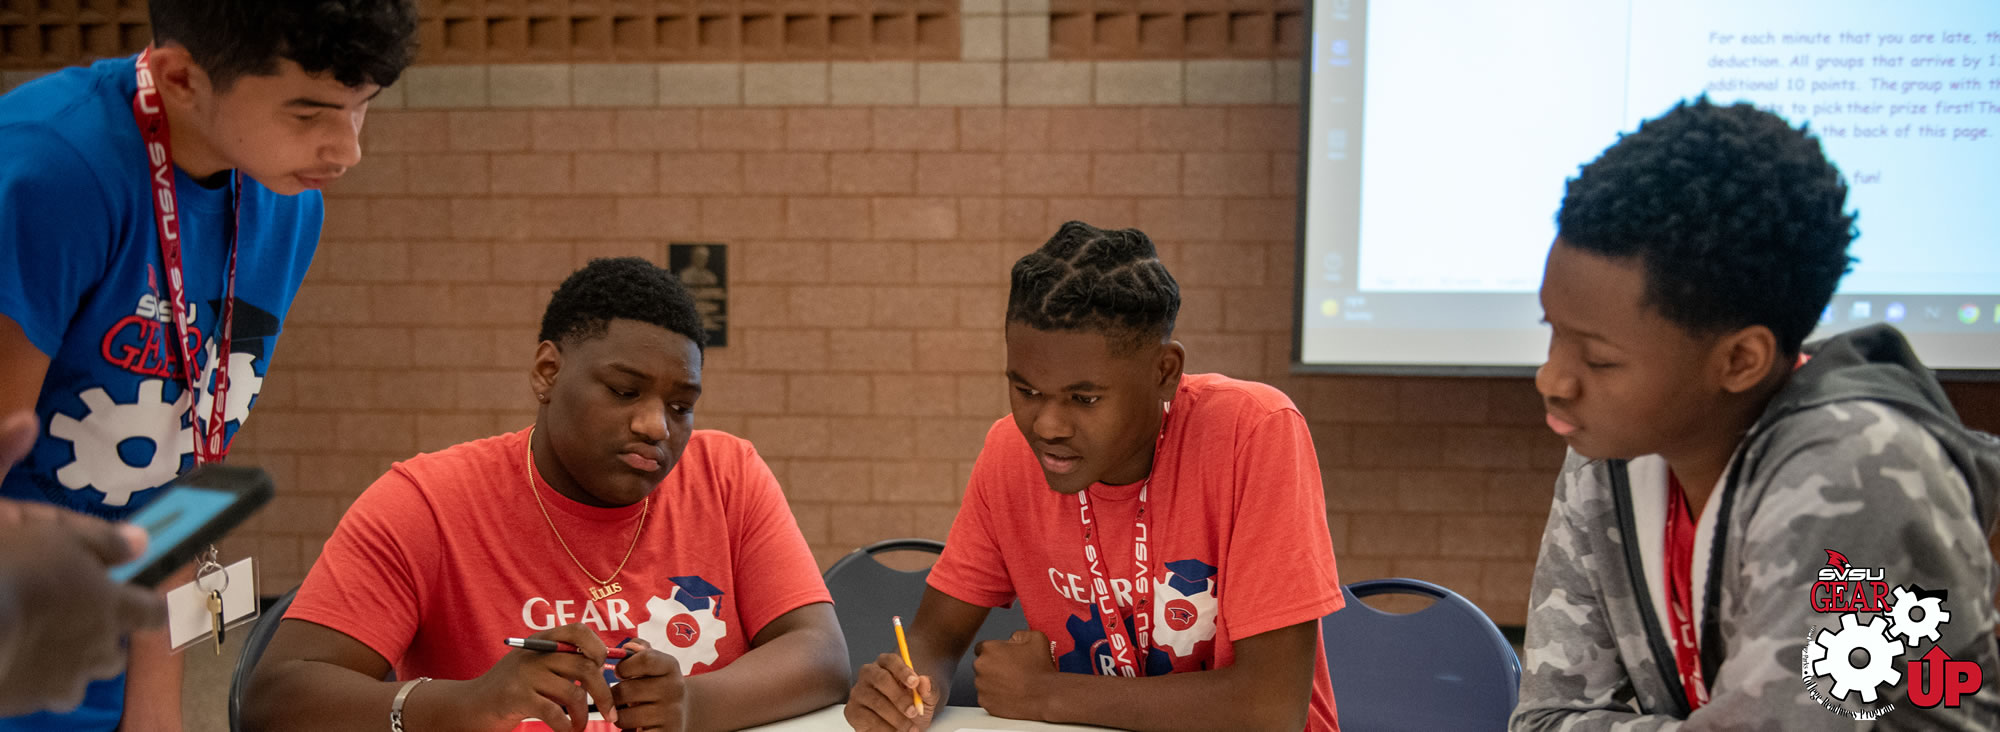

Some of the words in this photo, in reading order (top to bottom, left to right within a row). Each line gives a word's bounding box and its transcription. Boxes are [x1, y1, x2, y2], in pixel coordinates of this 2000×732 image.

[1709, 31, 1735, 44] For
[1741, 31, 1775, 44] each
[1782, 32, 1830, 44] minute
[1839, 31, 1870, 44] that
[1878, 34, 1903, 47] you
[1910, 34, 1934, 44] are
[1707, 55, 1784, 68] deduction.
[1789, 55, 1809, 67] All
[1815, 57, 1864, 71] groups
[1871, 55, 1903, 68] that
[1910, 56, 1955, 68] arrive
[1962, 54, 1981, 71] by
[136, 49, 159, 114] VSU
[1707, 77, 1779, 92] additional
[1787, 77, 1806, 91] 10
[1870, 77, 1897, 91] The
[1901, 79, 1942, 94] group
[1949, 78, 1981, 91] with
[1792, 101, 1807, 114] to
[1812, 101, 1844, 116] pick
[1846, 101, 1883, 115] their
[1889, 102, 1927, 117] prize
[1823, 125, 1846, 137] the
[1853, 124, 1888, 138] back
[1894, 122, 1911, 138] of
[1918, 124, 1946, 138] this
[148, 141, 178, 240] SVSU
[169, 267, 191, 361] SVSU
[209, 366, 227, 456] SVSU
[1078, 489, 1091, 525] SU
[1135, 522, 1149, 594] SVSU
[1084, 544, 1115, 614] SVSU
[522, 596, 636, 632] GEAR
